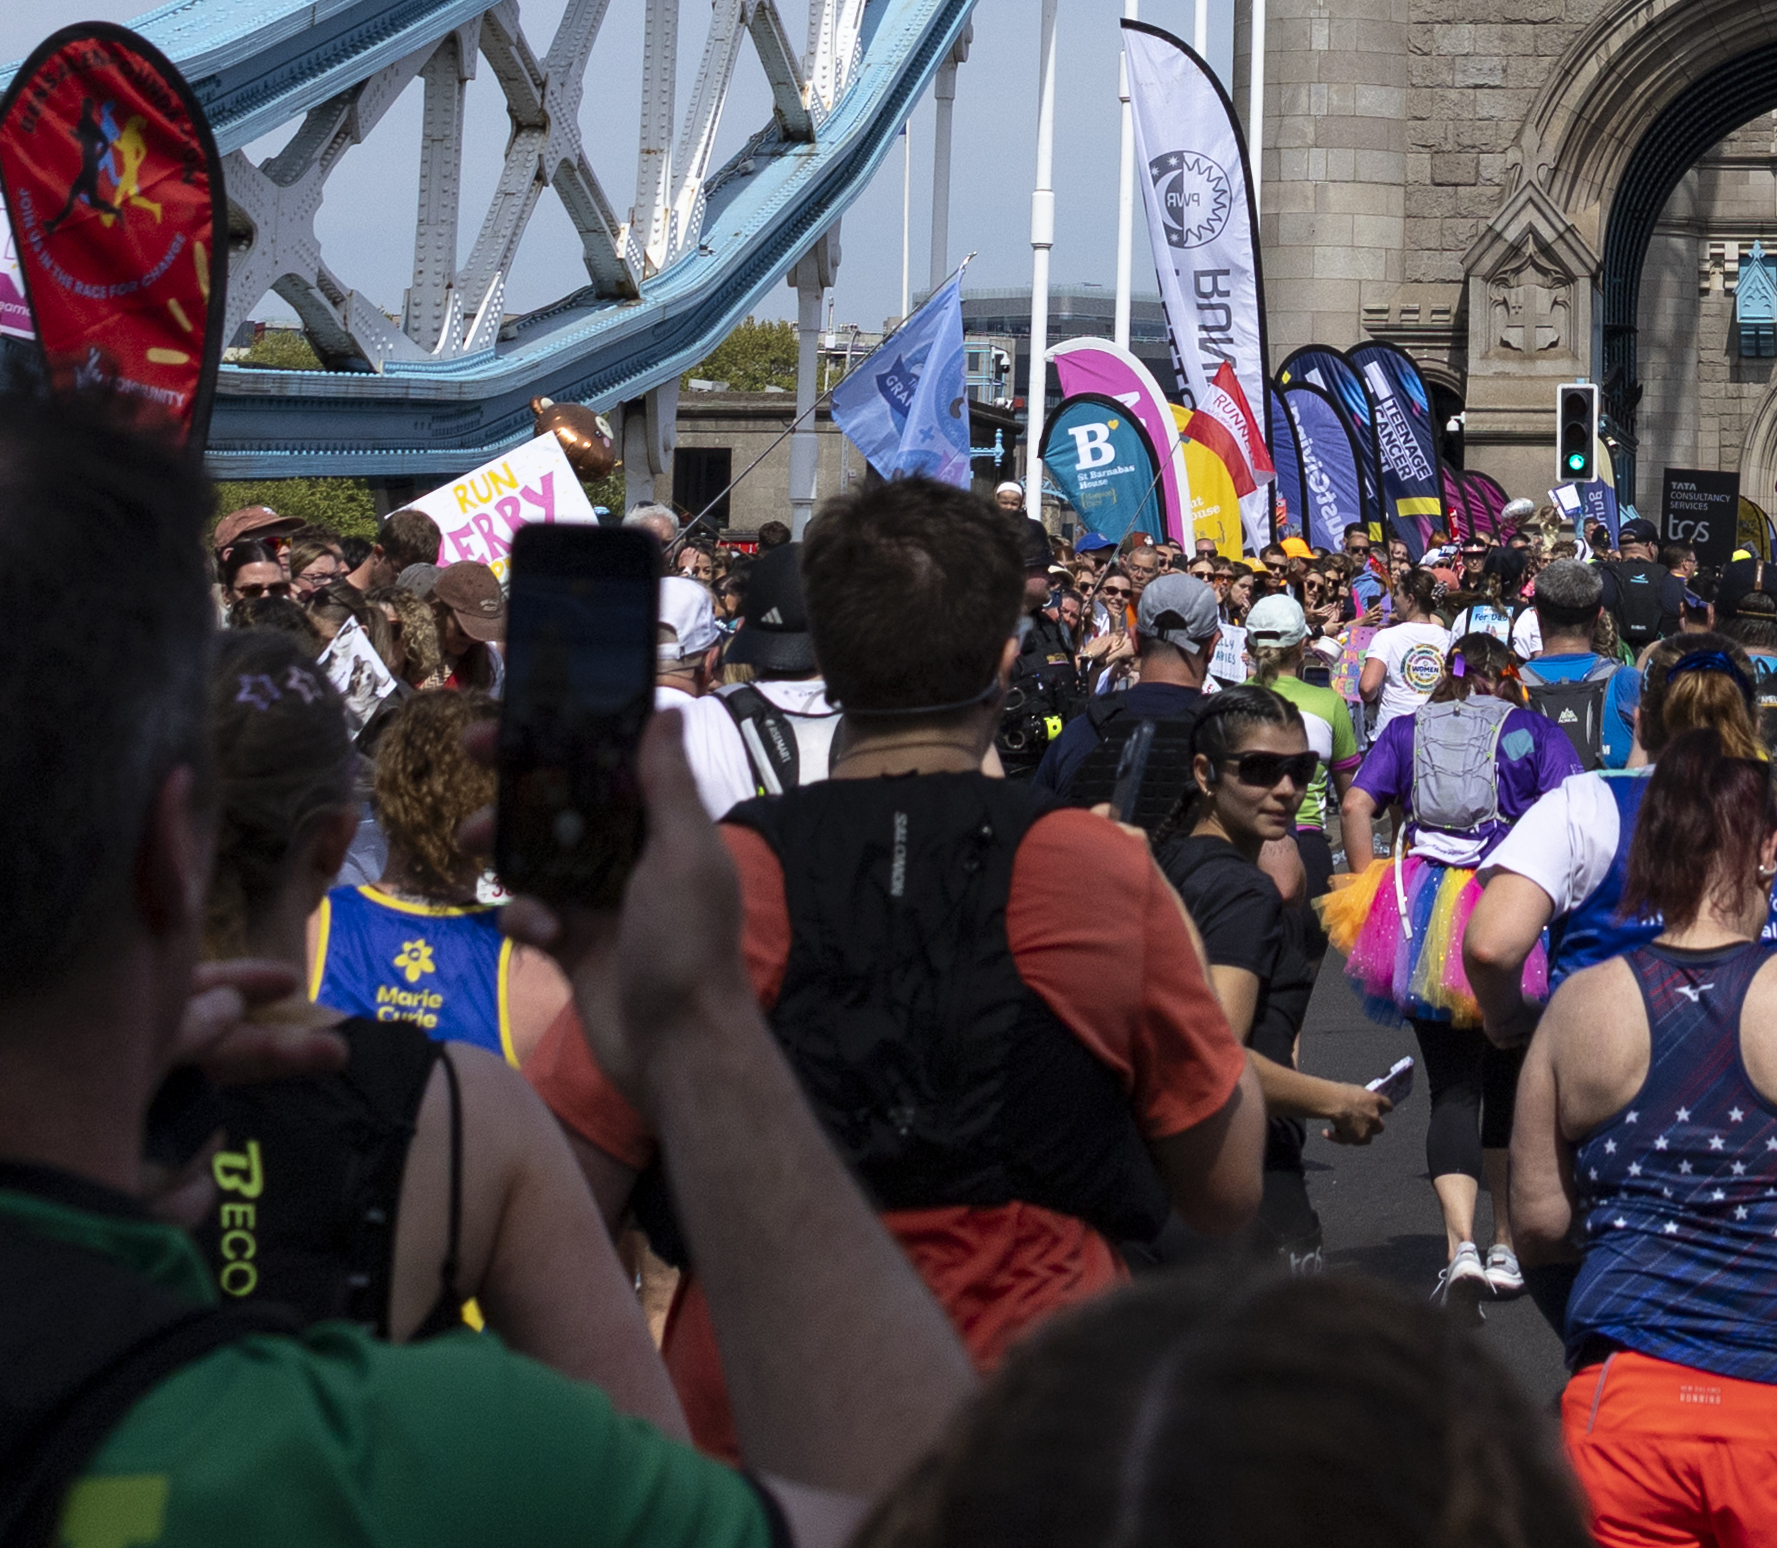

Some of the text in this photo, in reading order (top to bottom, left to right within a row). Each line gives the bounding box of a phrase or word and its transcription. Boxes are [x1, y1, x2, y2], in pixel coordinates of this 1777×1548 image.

[52, 267, 73, 290] THE
[74, 281, 107, 299] RACE
[109, 280, 138, 297] FOR
[141, 232, 186, 288] CHANGE
[1067, 422, 1116, 471] B
[1376, 407, 1412, 478] CANCER
[1385, 399, 1430, 479] TEENAGE
[1077, 464, 1135, 482] St Barnabas
[1078, 477, 1108, 490] House
[452, 461, 520, 514] RUN
[1670, 491, 1731, 503] CONSULTANCY
[1671, 481, 1697, 491] TATA
[1191, 504, 1221, 522] ouse
[1670, 500, 1709, 511] SERVICES
[1667, 513, 1710, 543] tcs
[1411, 666, 1440, 674] WOMEN
[376, 985, 444, 1009] Marie
[211, 1139, 264, 1297] BECO
